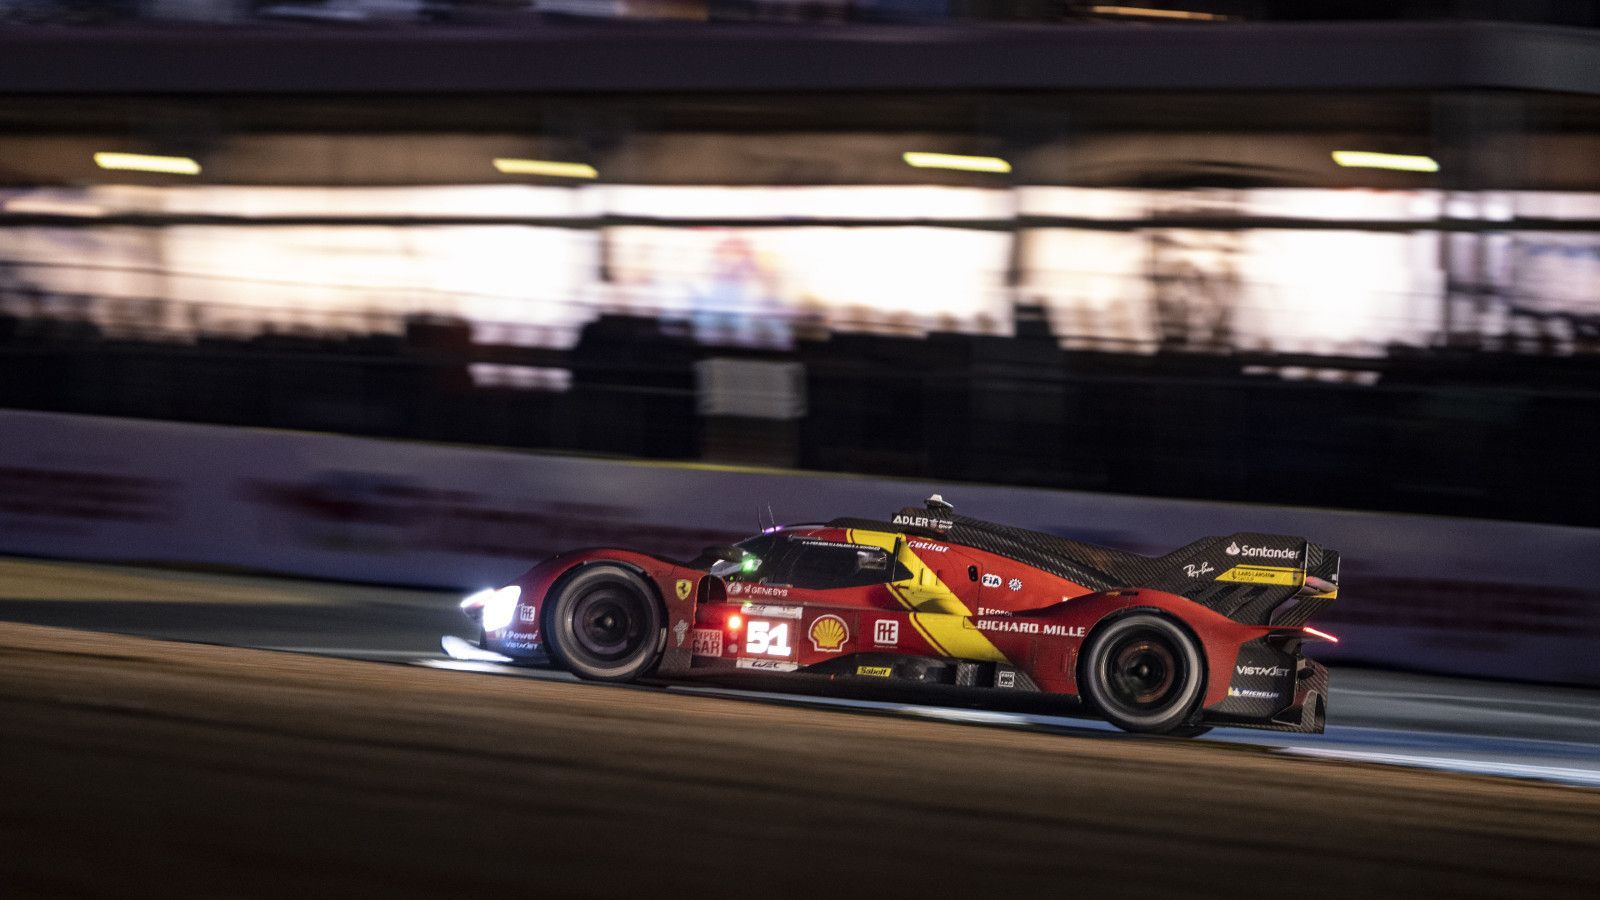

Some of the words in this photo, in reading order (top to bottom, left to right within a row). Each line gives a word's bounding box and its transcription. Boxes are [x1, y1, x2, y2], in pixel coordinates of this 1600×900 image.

[892, 515, 928, 527] ADLER
[907, 540, 950, 553] Cetilar
[1241, 545, 1300, 559] Santander
[751, 586, 788, 597] GENESYS
[977, 620, 1039, 634] RICHARD
[1043, 624, 1086, 637] MILLE
[745, 621, 791, 656] 51
[692, 640, 720, 654] CAR
